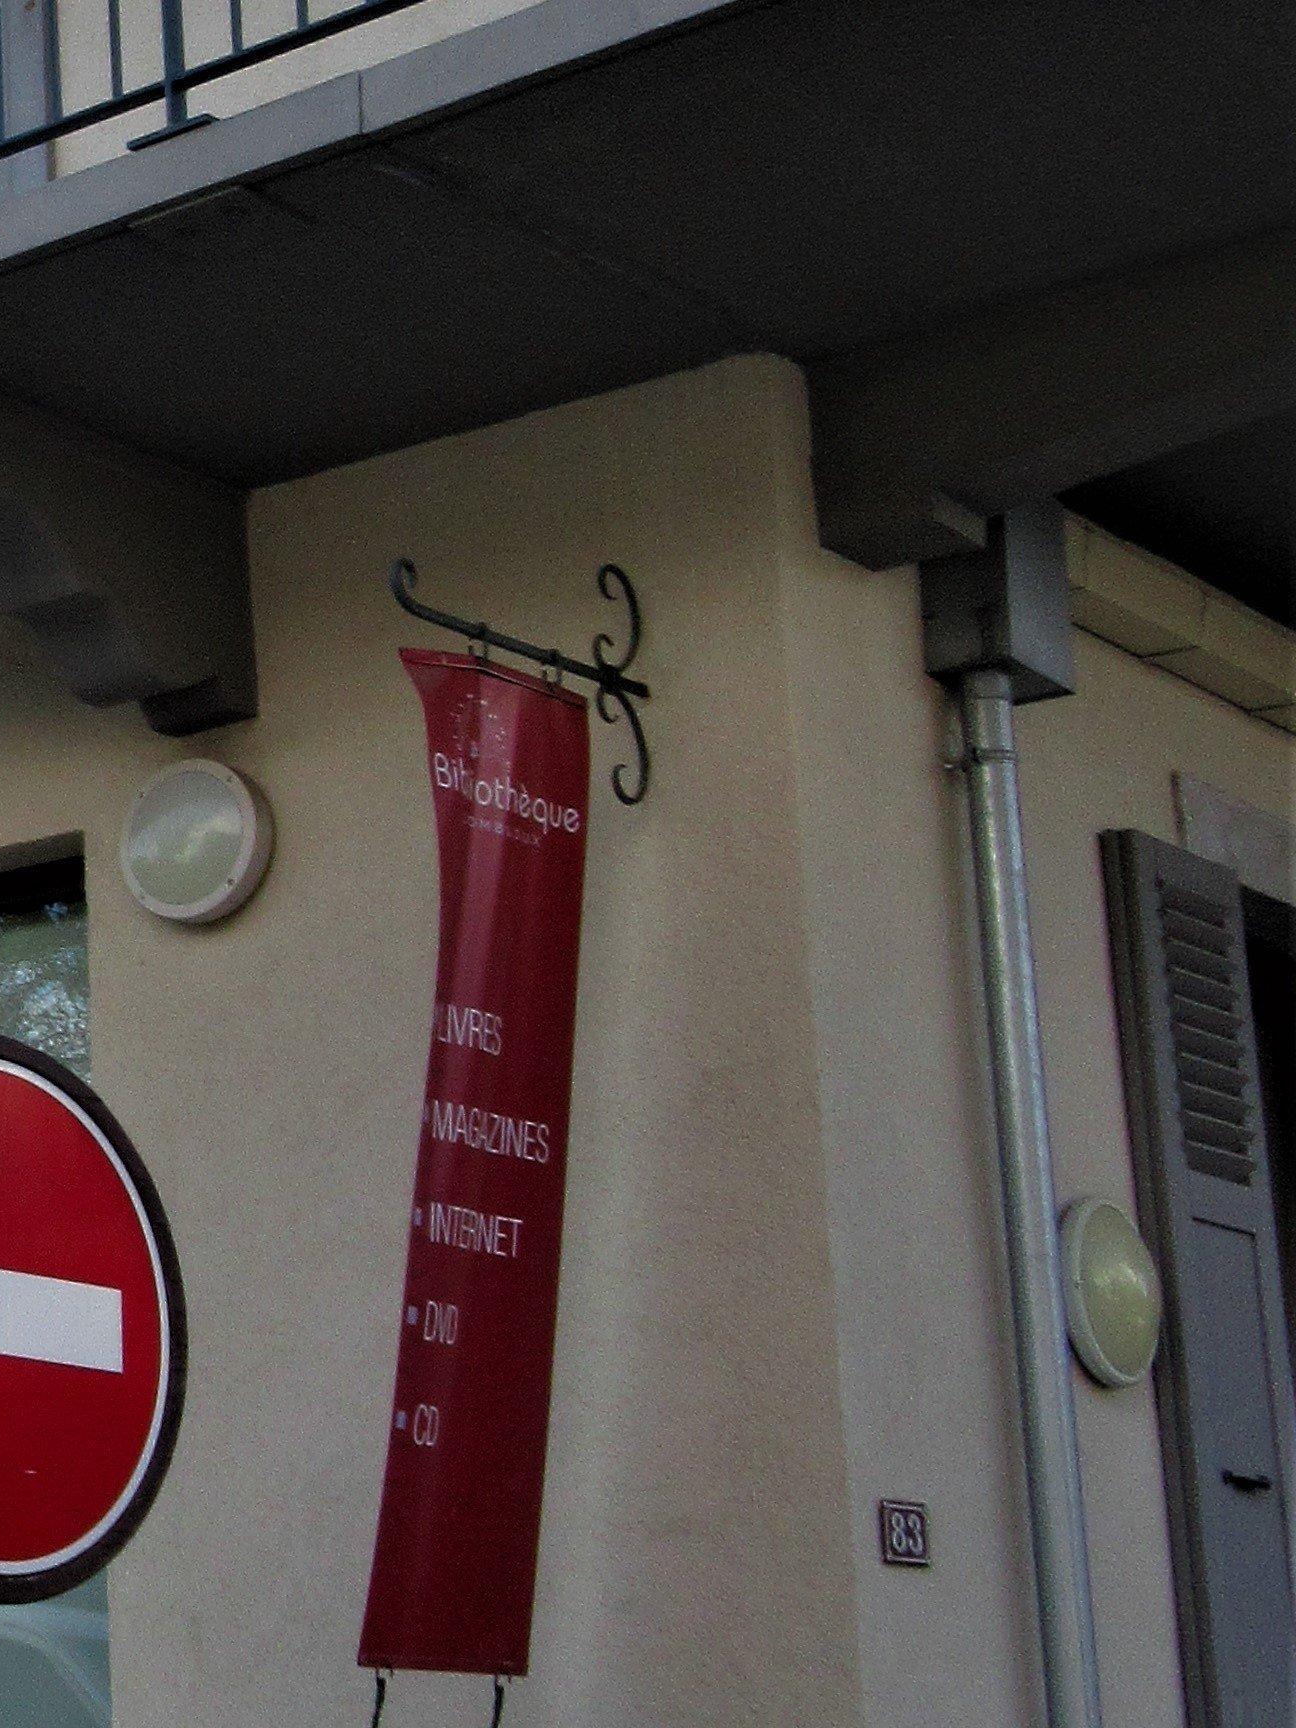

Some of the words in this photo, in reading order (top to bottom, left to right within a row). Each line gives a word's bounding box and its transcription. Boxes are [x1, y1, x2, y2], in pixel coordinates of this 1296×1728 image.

[434, 752, 580, 835] Bibothèque
[433, 1099, 550, 1164] MAGAZINES
[430, 1202, 523, 1258] INTERNET
[423, 1300, 458, 1345] DVD
[413, 1404, 439, 1446] CD
[892, 1512, 923, 1555] 83
